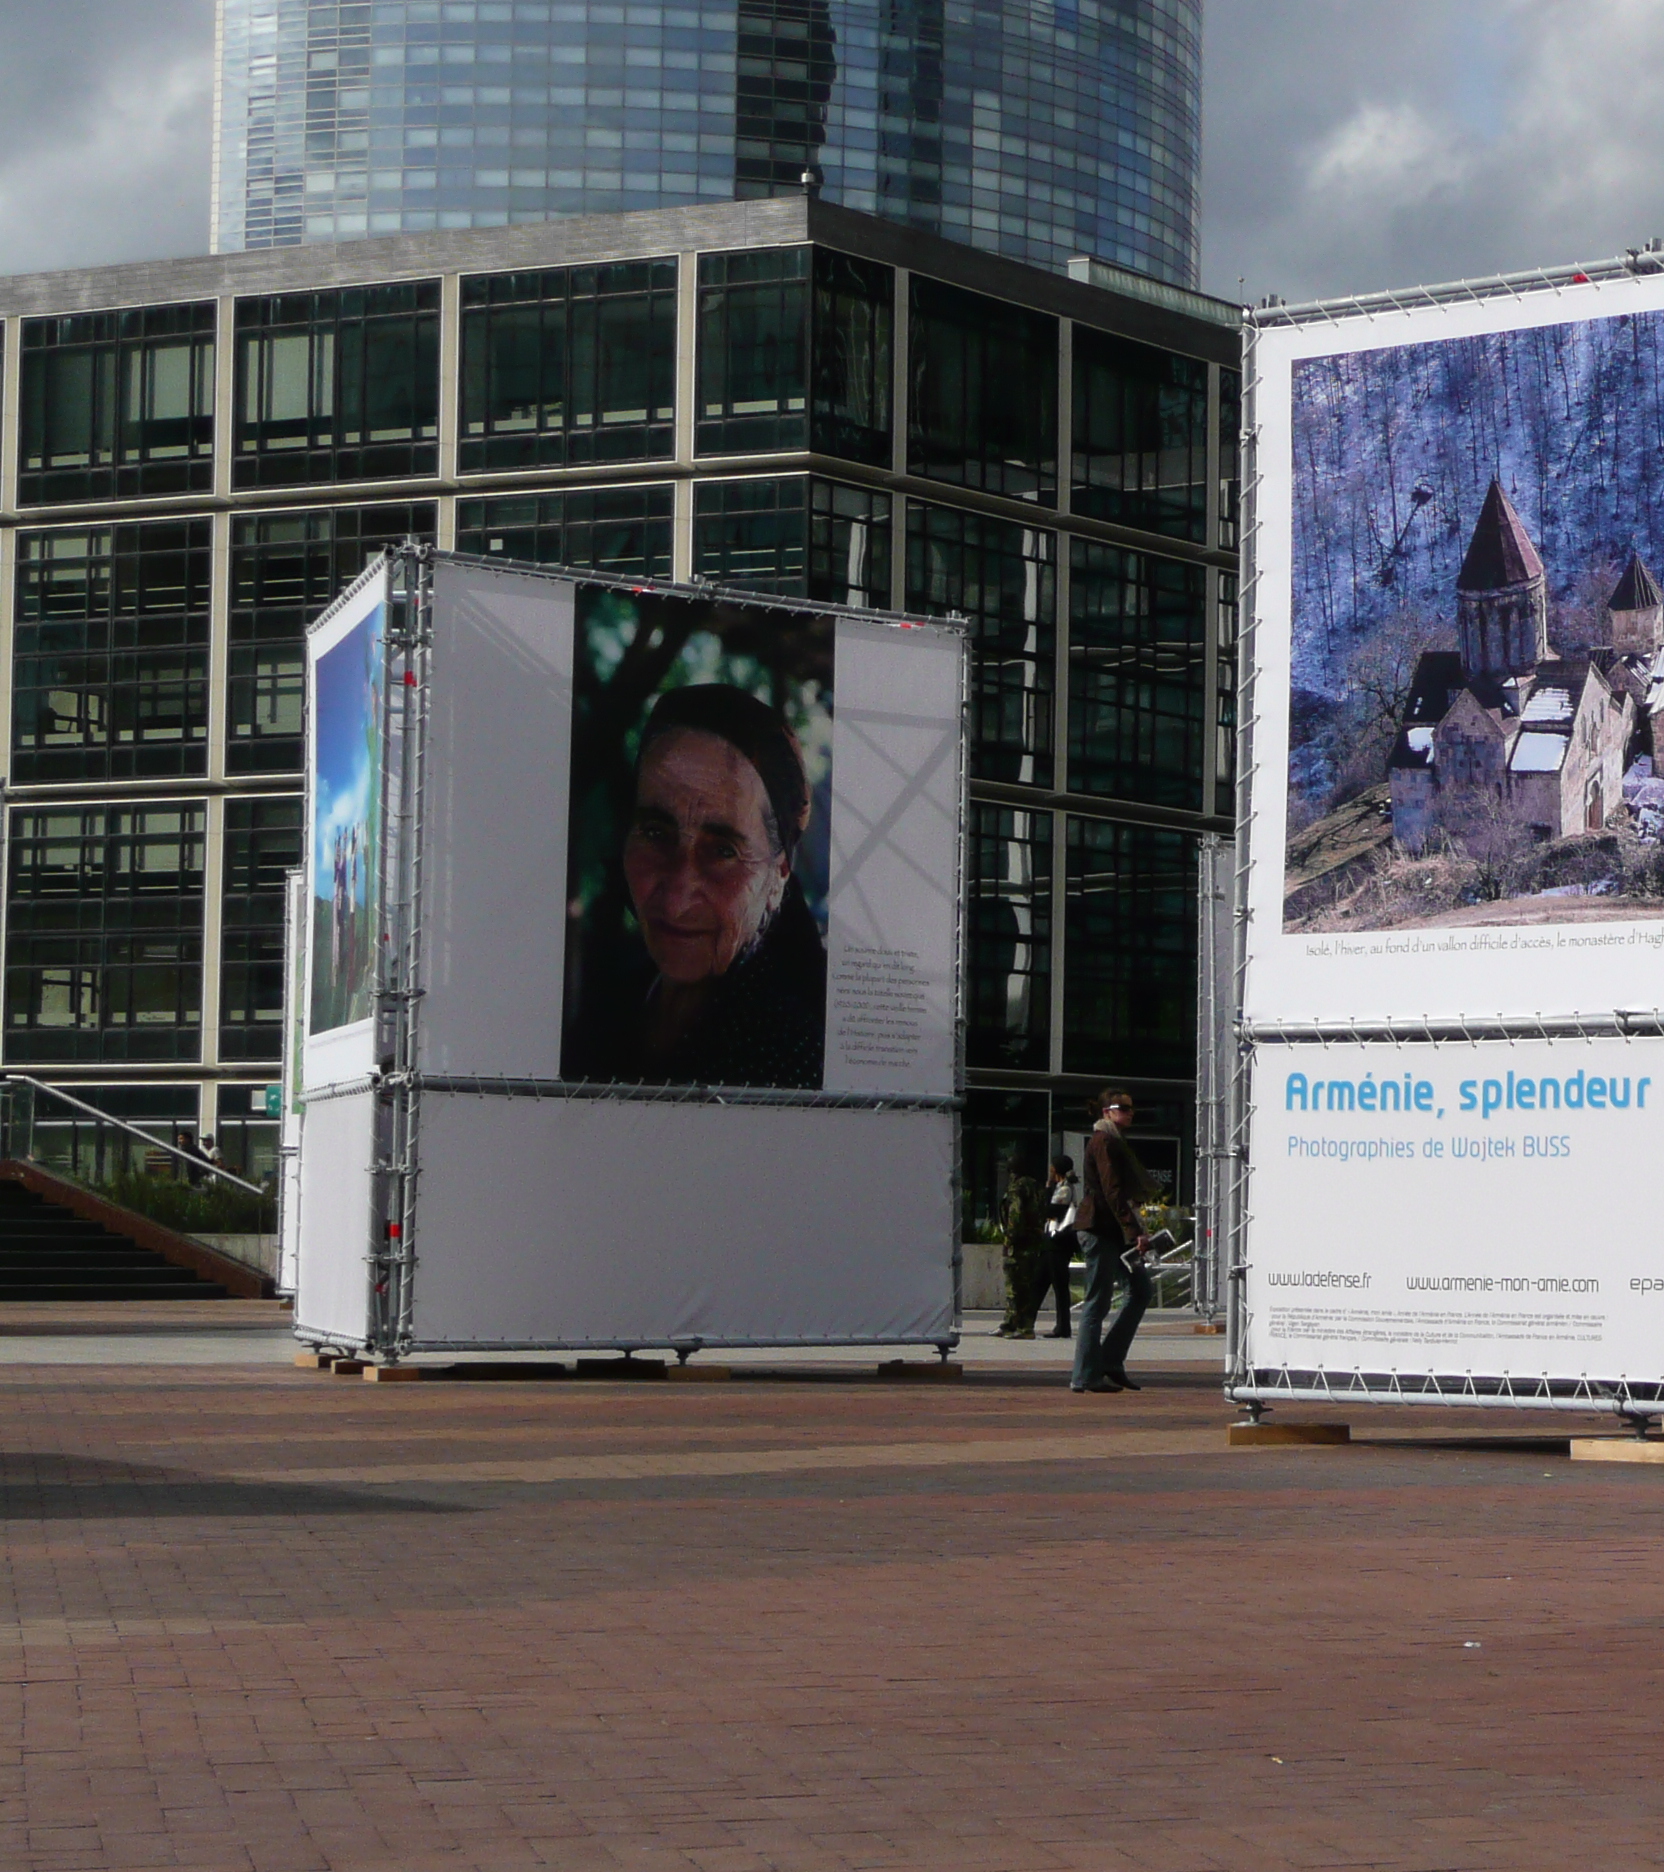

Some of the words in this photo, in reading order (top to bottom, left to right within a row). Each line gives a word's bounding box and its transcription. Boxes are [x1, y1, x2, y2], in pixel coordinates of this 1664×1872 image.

[1306, 940, 1332, 958] Isolé,
[1335, 939, 1367, 956] l'hiver,
[1369, 946, 1382, 954] au
[1385, 937, 1410, 953] fond
[1411, 935, 1434, 952] d'un
[1437, 936, 1466, 951] vallon
[1469, 934, 1508, 950] difficile
[1510, 932, 1554, 950] d'accès,
[1556, 932, 1566, 947] le
[1568, 933, 1624, 946] monastère
[1286, 1072, 1446, 1119] Arménie,
[1461, 1070, 1652, 1120] splendeur
[1288, 1136, 1415, 1161] Photographies
[1422, 1136, 1444, 1158] de
[1451, 1136, 1515, 1162] Wojtek
[1522, 1135, 1570, 1158] BUSS
[1268, 1270, 1372, 1288] www.ladefense.fr
[1406, 1274, 1600, 1293] www.armenie-mon-amie.com
